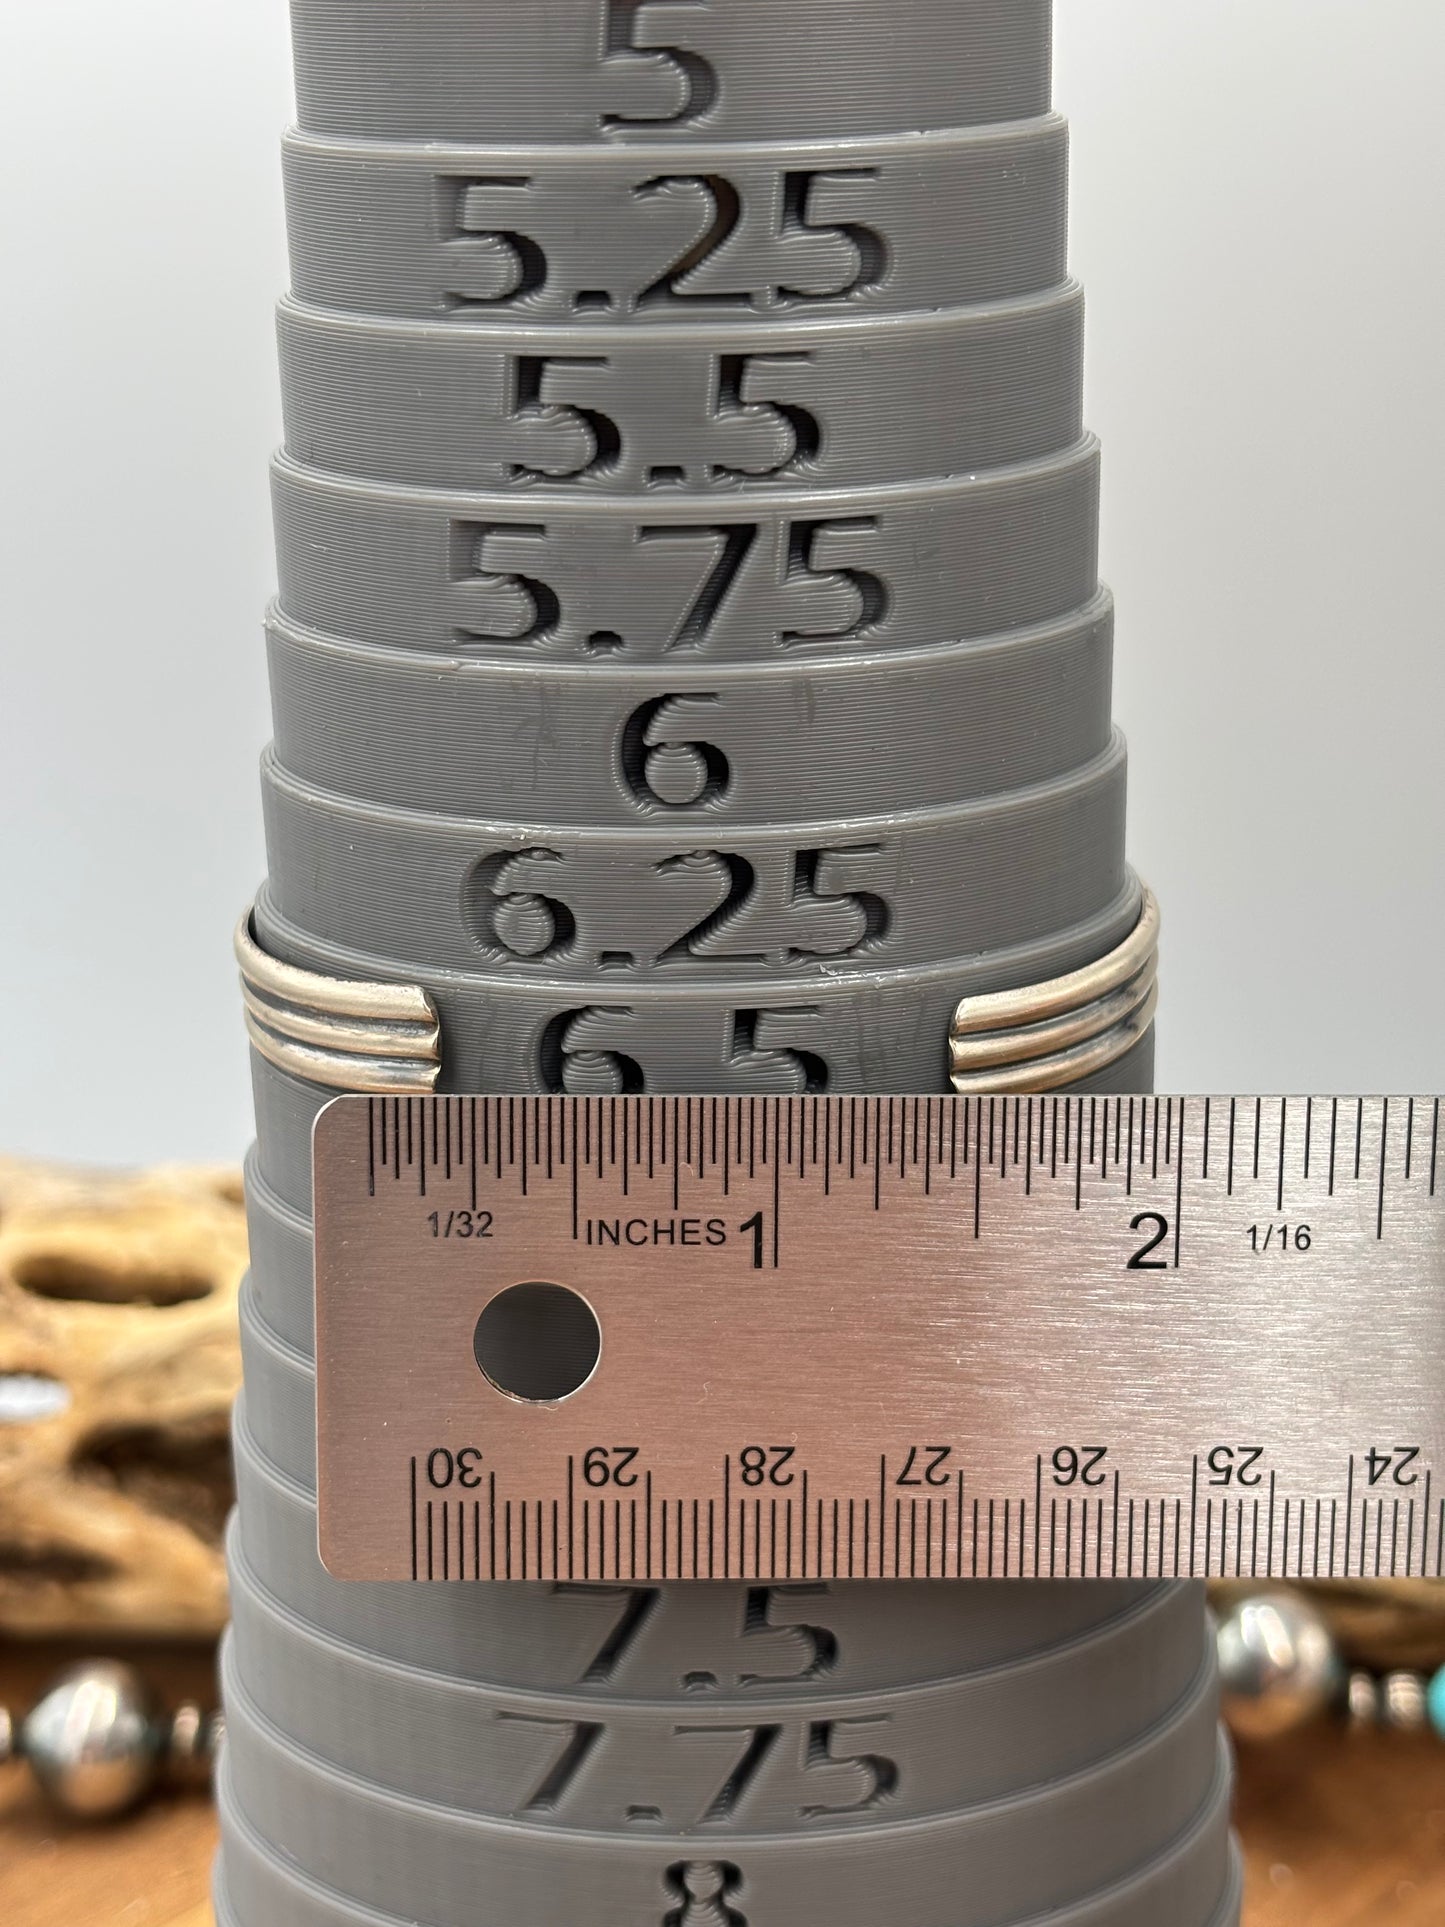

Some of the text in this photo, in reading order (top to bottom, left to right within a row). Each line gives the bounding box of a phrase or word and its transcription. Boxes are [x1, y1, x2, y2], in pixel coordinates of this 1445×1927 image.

[598, 0, 722, 132] 5
[434, 166, 892, 312] 5.25
[502, 352, 822, 486] 5.5
[446, 517, 892, 653] 5.75
[612, 691, 734, 814] 6
[461, 846, 892, 968] 6.25
[534, 1004, 829, 1094] 65
[427, 1211, 1312, 1269] 1/32 INCHES 1 2 1/16
[427, 1446, 1420, 1488] 24 25 26 27 28 29 30
[553, 1582, 842, 1692] 7.5
[496, 1710, 900, 1823] 7.75
[660, 1859, 748, 1927] 8
